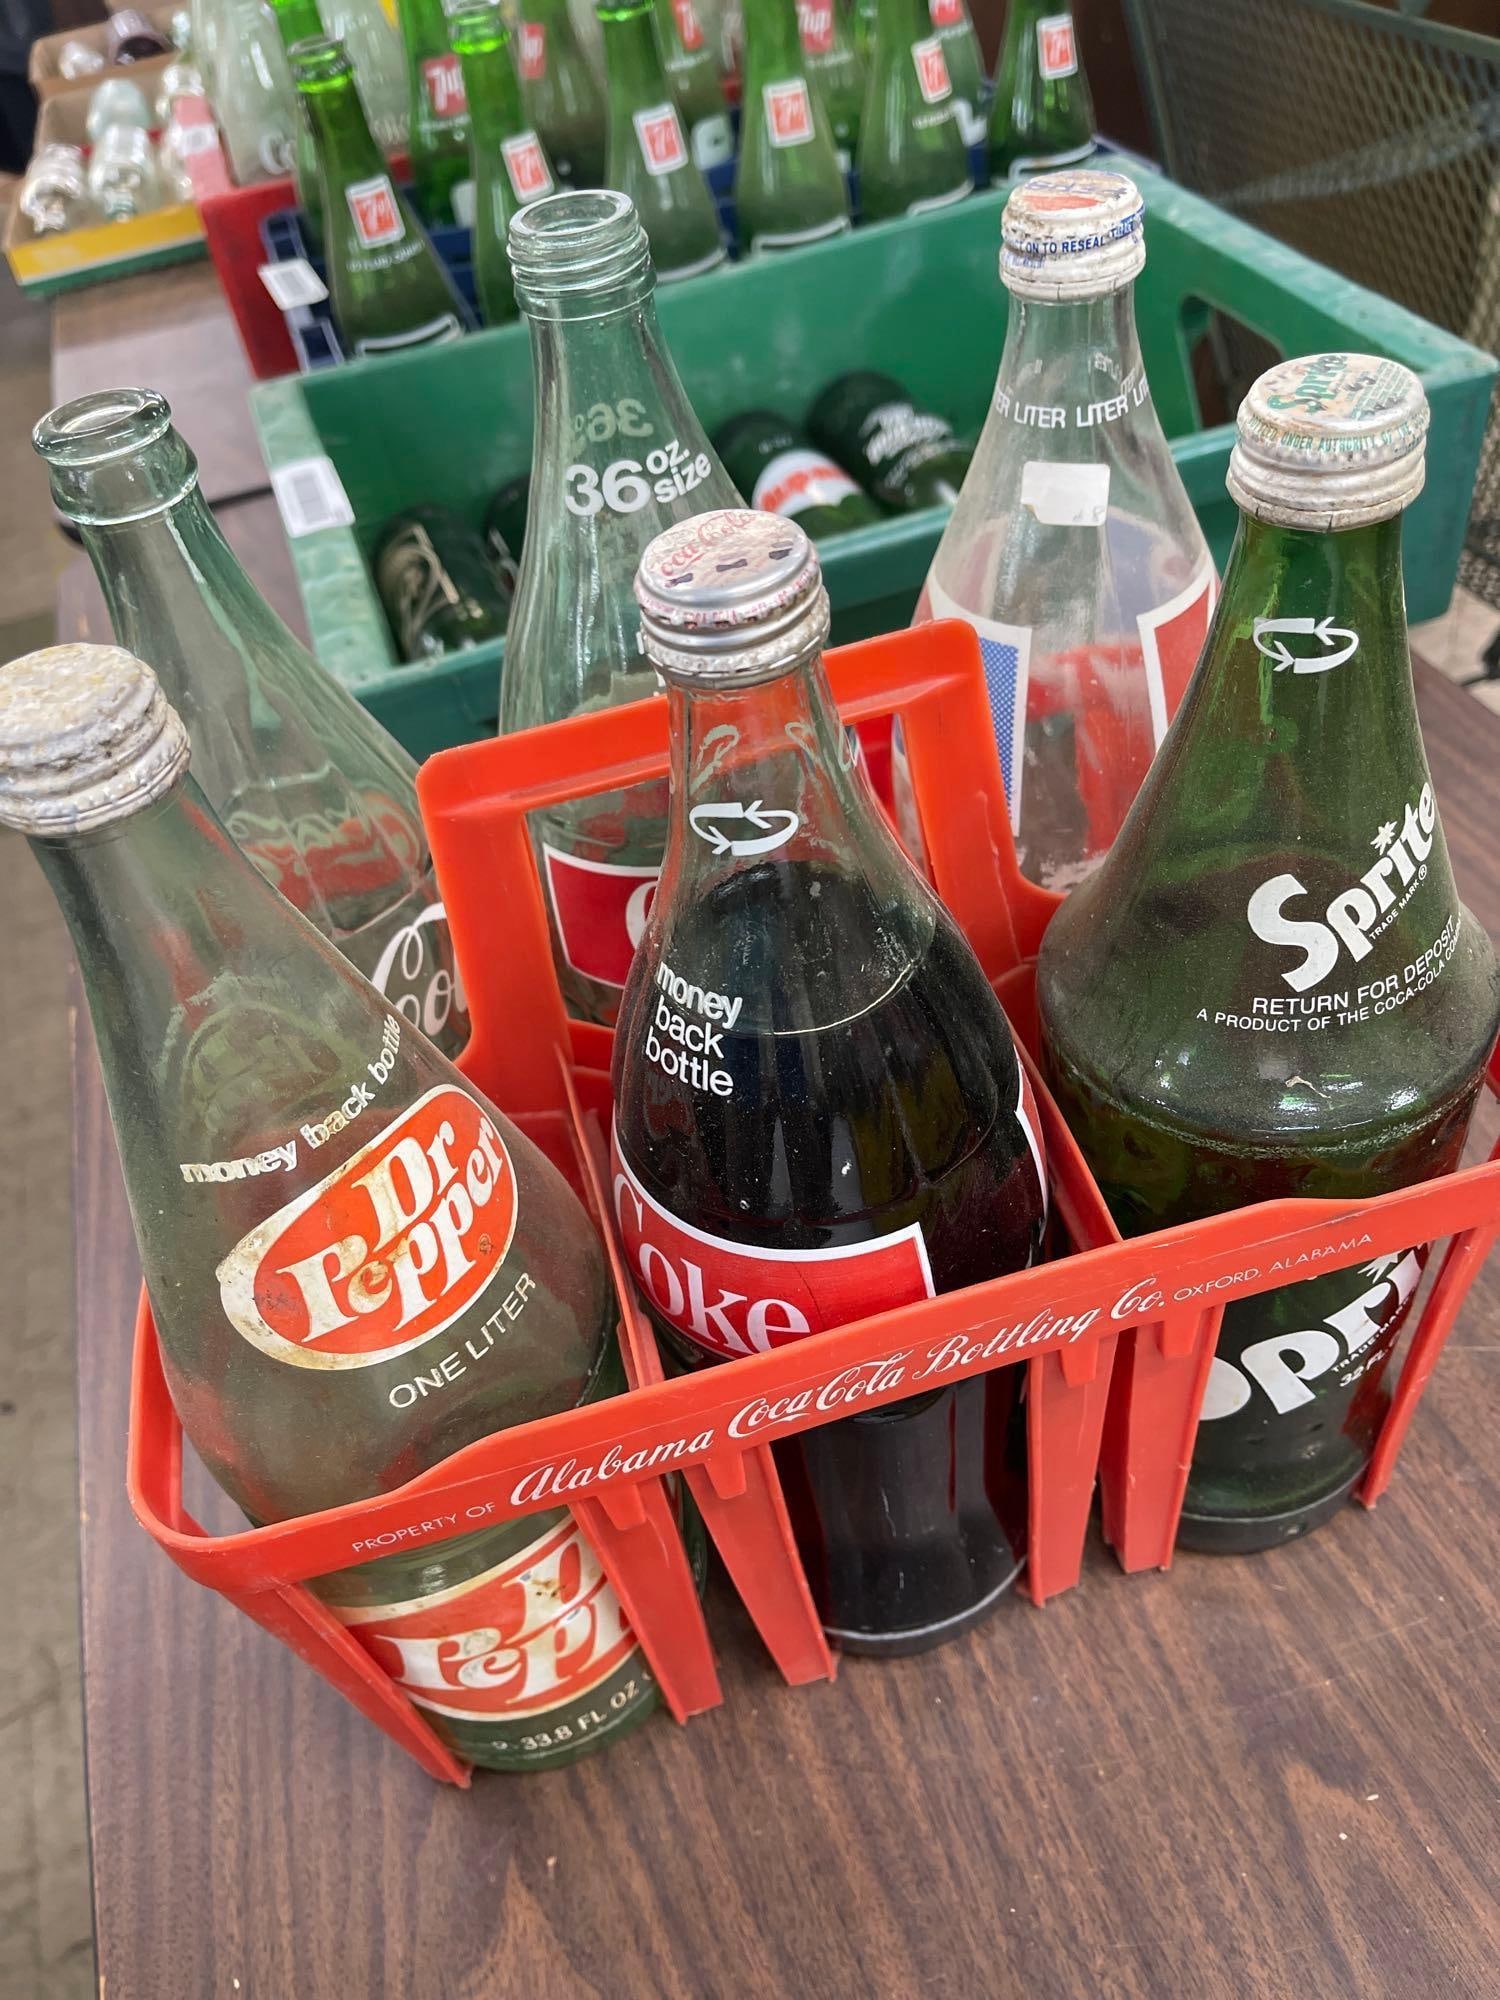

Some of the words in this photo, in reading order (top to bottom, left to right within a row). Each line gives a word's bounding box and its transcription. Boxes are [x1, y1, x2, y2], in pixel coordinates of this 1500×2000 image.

[1026, 242, 1039, 254] ON
[1043, 242, 1057, 255] TO
[1061, 237, 1106, 254] RESEAL
[1014, 402, 1066, 429] LITER
[1076, 395, 1129, 428] LITER
[565, 459, 651, 517] 36
[646, 438, 691, 475] oz.
[653, 453, 712, 503] size
[1247, 782, 1436, 993] Sprite
[1369, 908, 1399, 940] TRADE
[1398, 879, 1420, 910] MARK
[656, 961, 743, 1030] money
[1196, 1007, 1208, 1021] A
[1214, 1011, 1302, 1033] PRODUCT
[1307, 1017, 1331, 1031] OF
[1336, 1006, 1370, 1027] THE
[1374, 959, 1445, 1014] COCA-COLA
[1252, 991, 1349, 1016] RETURN
[1357, 974, 1399, 1004] FOR
[1403, 914, 1455, 984] DEPOSIT
[645, 1025, 734, 1097] bottle
[655, 994, 725, 1059] back
[179, 1139, 297, 1184] money
[299, 1081, 376, 1150] back
[367, 1013, 402, 1086] bottle
[351, 1119, 459, 1251] Dr
[275, 1115, 504, 1344] Pepper
[388, 1350, 468, 1409] ONE
[464, 1272, 536, 1360] LITER
[352, 1512, 458, 1553] PROPERTY
[465, 1501, 497, 1519] OF
[510, 1429, 715, 1507] Alabama
[911, 1307, 1103, 1381] Bottling
[1110, 1277, 1166, 1321] Co.
[1268, 1233, 1373, 1274] ALABAMA
[519, 1724, 573, 1751] 33.8
[577, 1709, 608, 1731] FL
[610, 1679, 640, 1709] OZ
